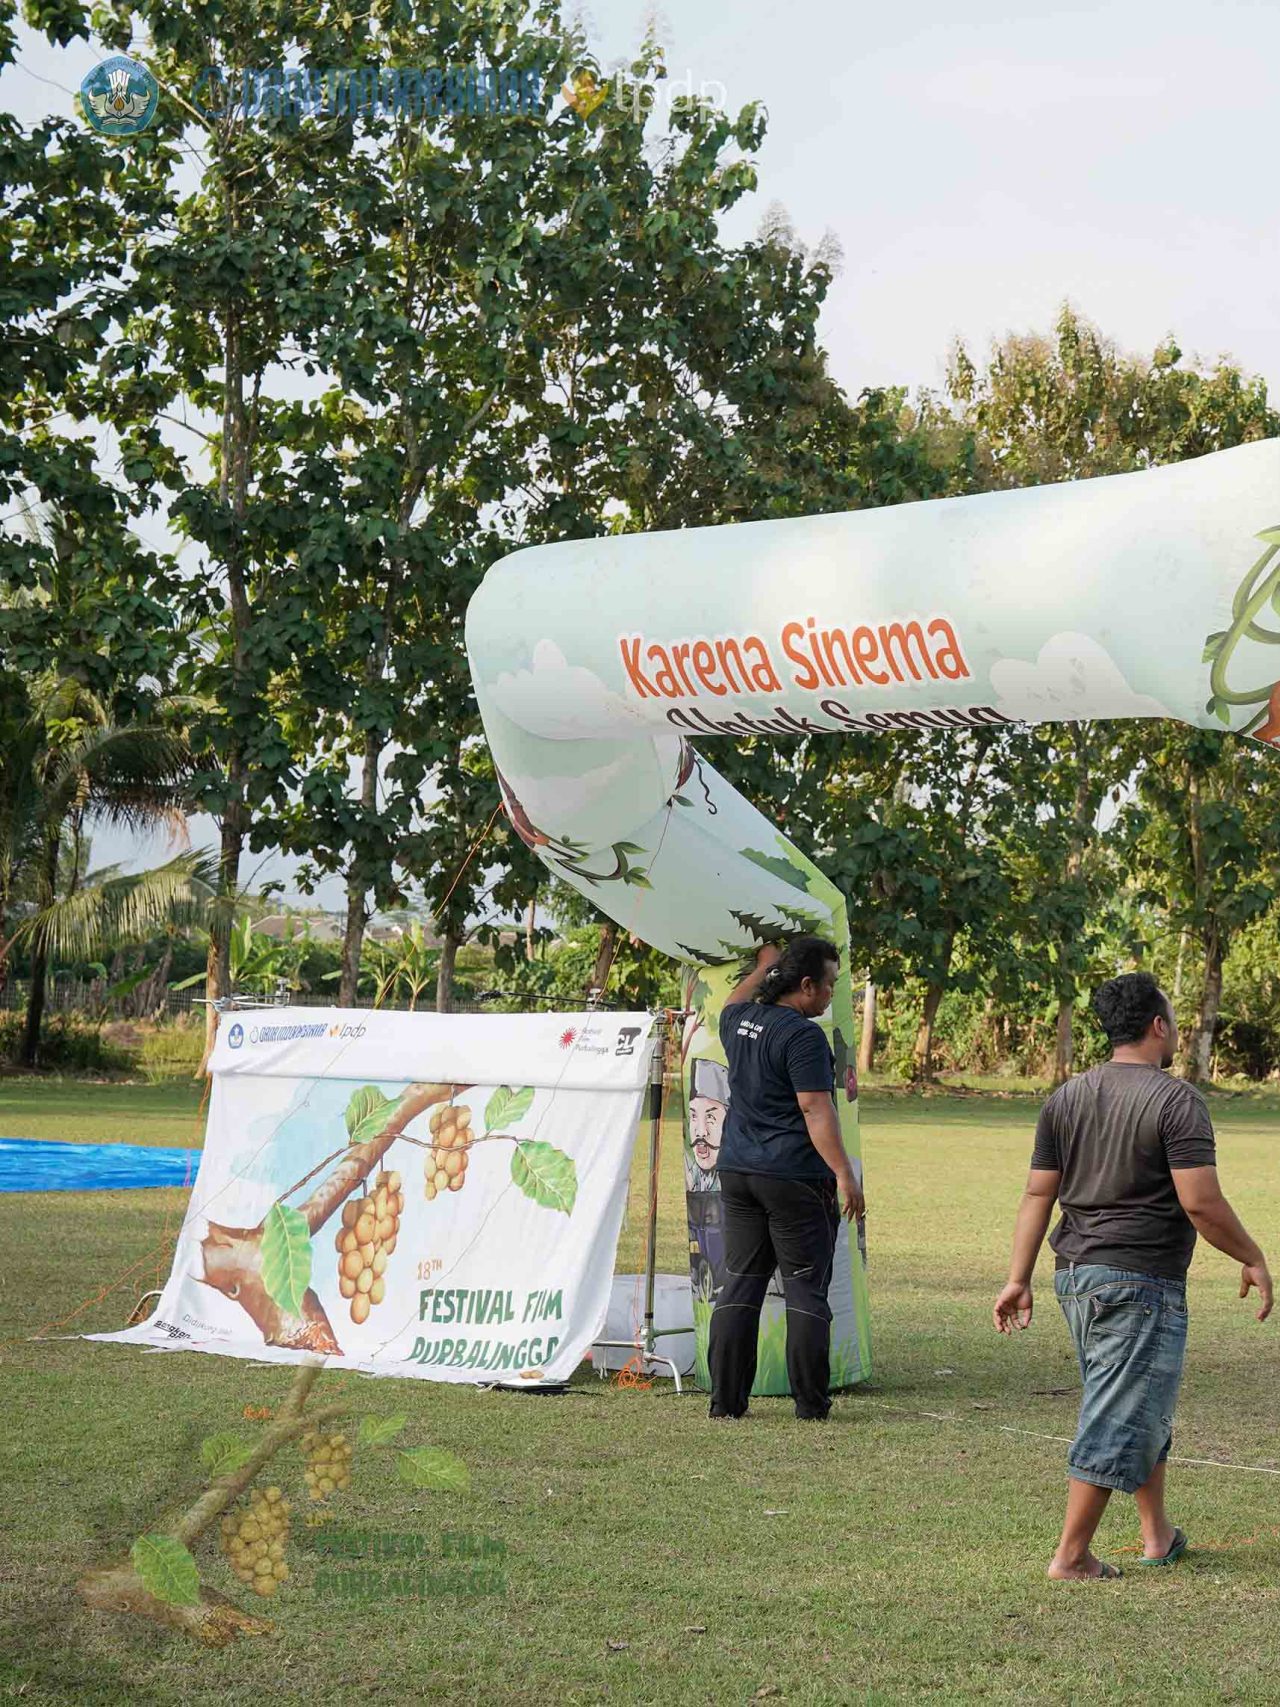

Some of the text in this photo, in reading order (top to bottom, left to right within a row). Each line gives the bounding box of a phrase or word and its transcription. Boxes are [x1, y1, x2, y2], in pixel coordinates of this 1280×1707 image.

[620, 616, 971, 699] Karena Sinema
[419, 1288, 563, 1324] FESTIVAL FILM
